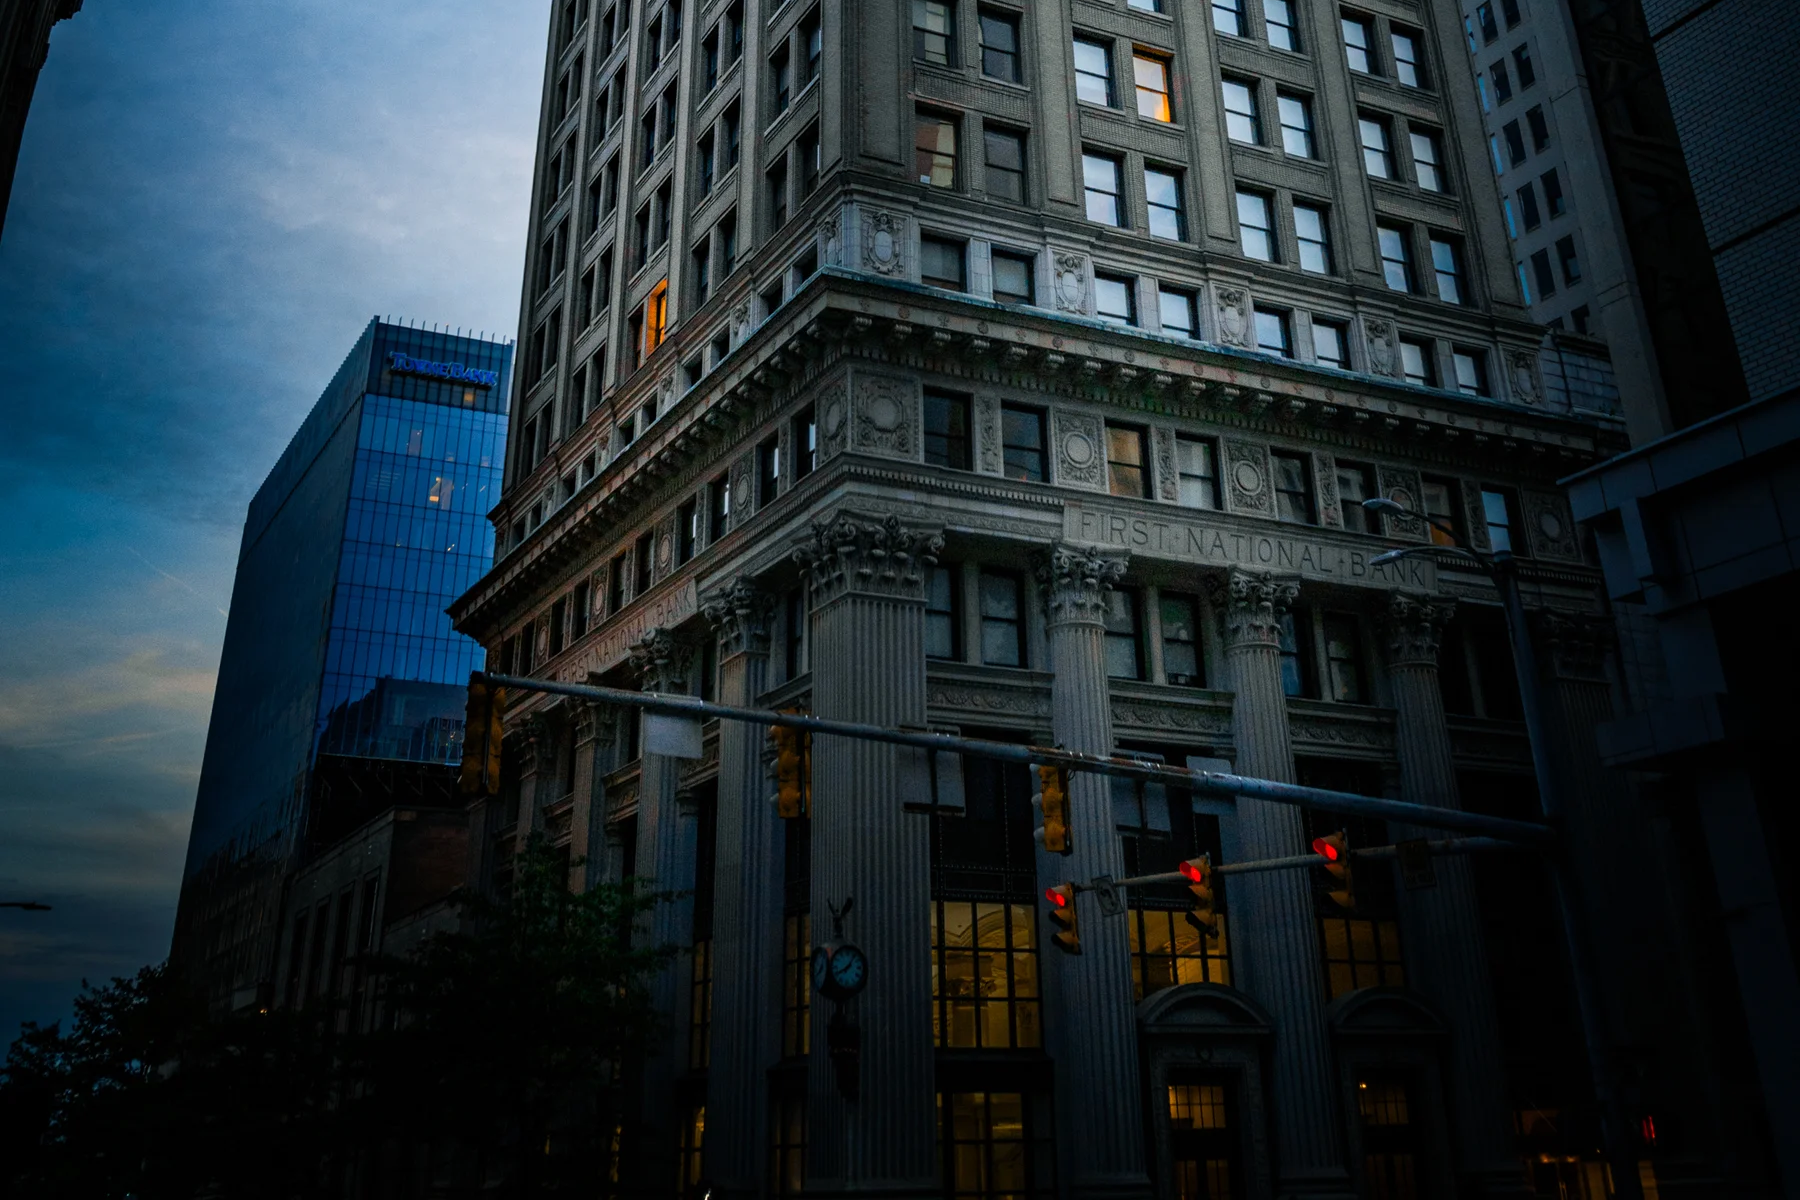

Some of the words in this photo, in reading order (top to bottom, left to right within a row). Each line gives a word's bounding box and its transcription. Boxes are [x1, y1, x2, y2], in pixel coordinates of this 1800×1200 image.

[1081, 511, 1169, 550] FIRST
[1187, 527, 1333, 573] NATIONAL
[1350, 551, 1424, 586] BANK
[656, 585, 691, 626] BANK
